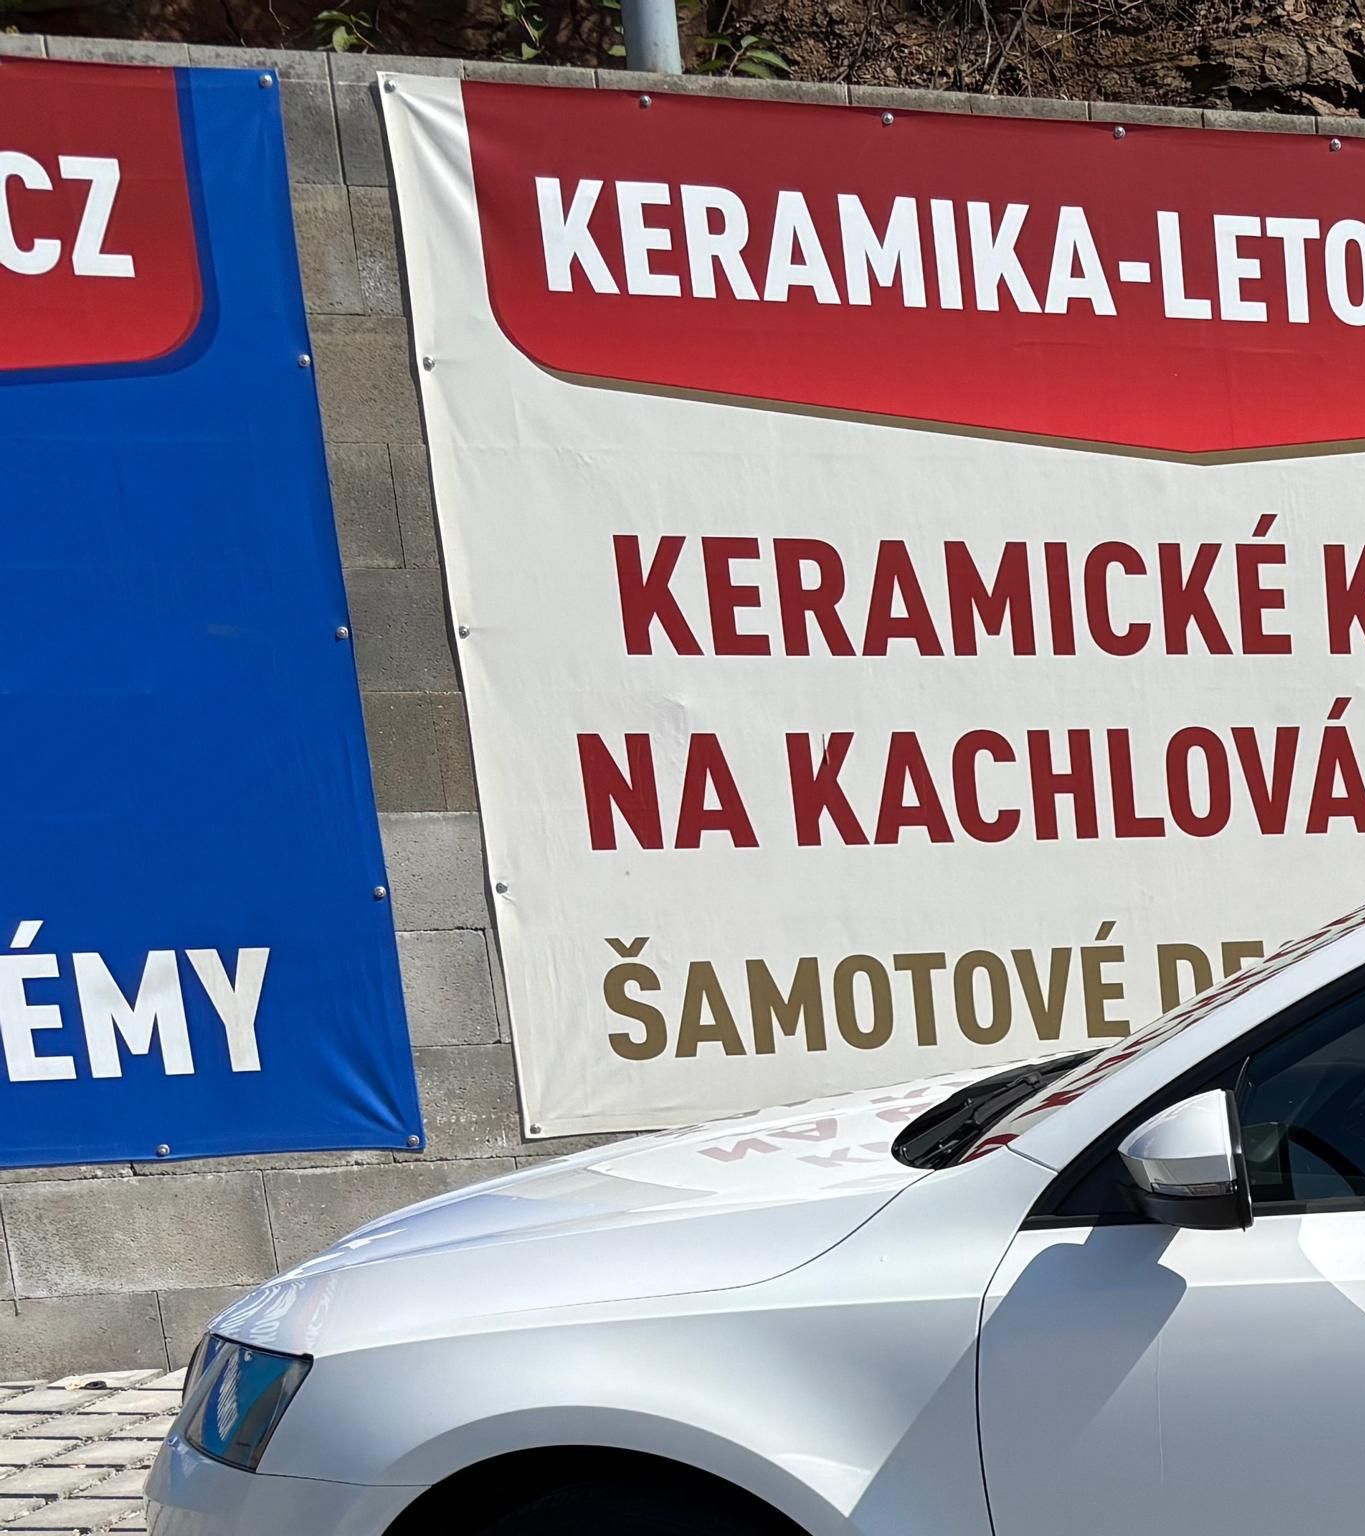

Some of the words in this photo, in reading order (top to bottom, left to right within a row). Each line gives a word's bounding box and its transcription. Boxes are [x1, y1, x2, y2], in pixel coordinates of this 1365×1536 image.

[613, 513, 1293, 657] KERAMICKÉ
[576, 732, 760, 851] NA
[603, 921, 1131, 1062] ŠAMOTOVÉ
